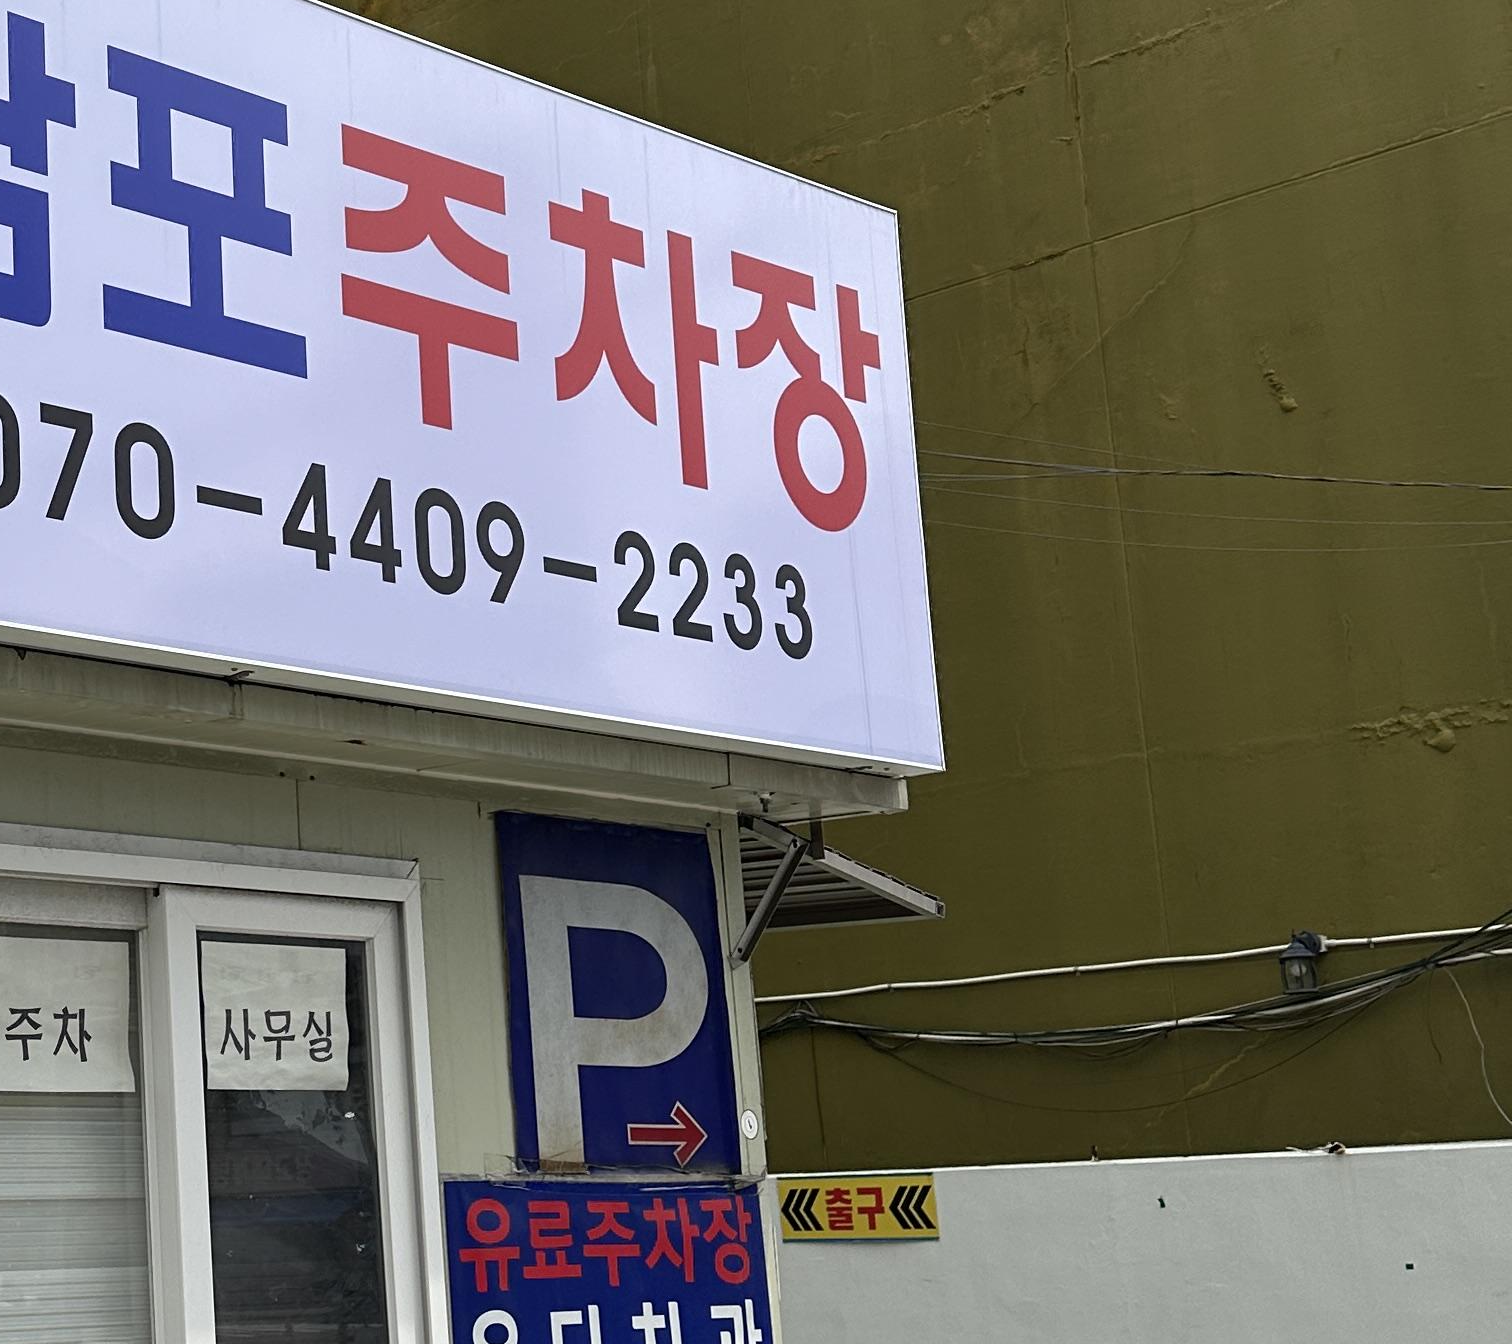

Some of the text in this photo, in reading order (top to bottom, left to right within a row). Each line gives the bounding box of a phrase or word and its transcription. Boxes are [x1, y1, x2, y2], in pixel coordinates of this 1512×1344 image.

[4, 1006, 93, 1062] 주차
[220, 1007, 334, 1063] 사무실
[518, 874, 709, 1169] P
[824, 1186, 886, 1232] 출구
[459, 1195, 754, 1293] 유료주차장
